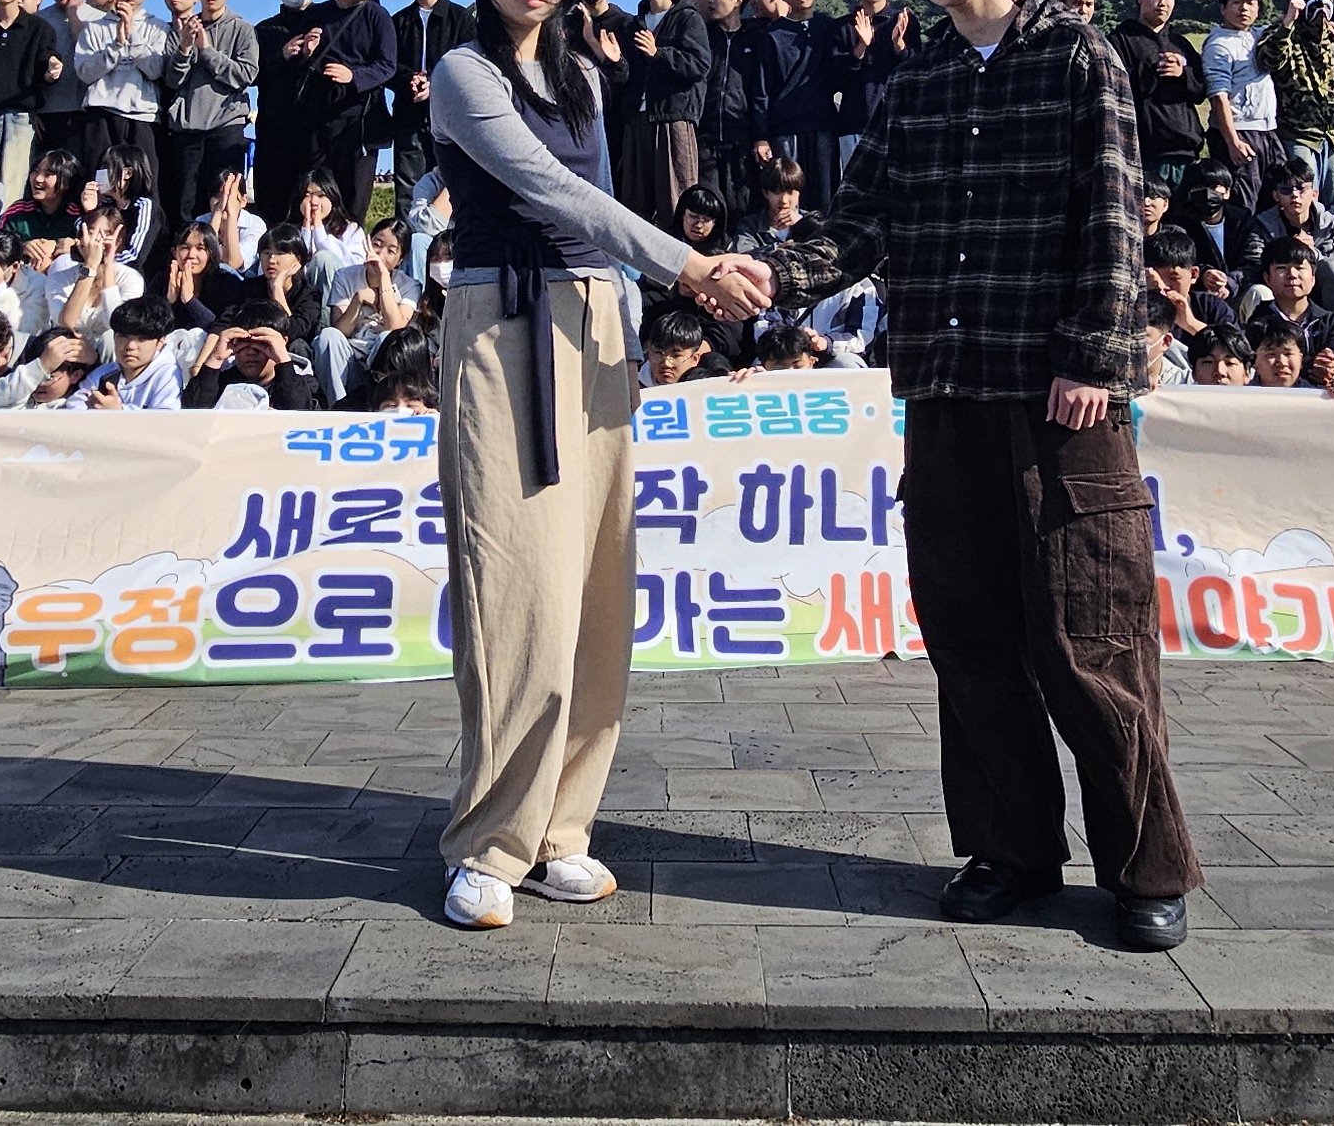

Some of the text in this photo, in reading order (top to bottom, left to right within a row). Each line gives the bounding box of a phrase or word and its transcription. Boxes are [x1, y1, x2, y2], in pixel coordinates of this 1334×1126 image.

[631, 397, 690, 443] 원
[634, 465, 709, 545] 작
[738, 463, 906, 546] 하나
[7, 573, 396, 664] 우정으로
